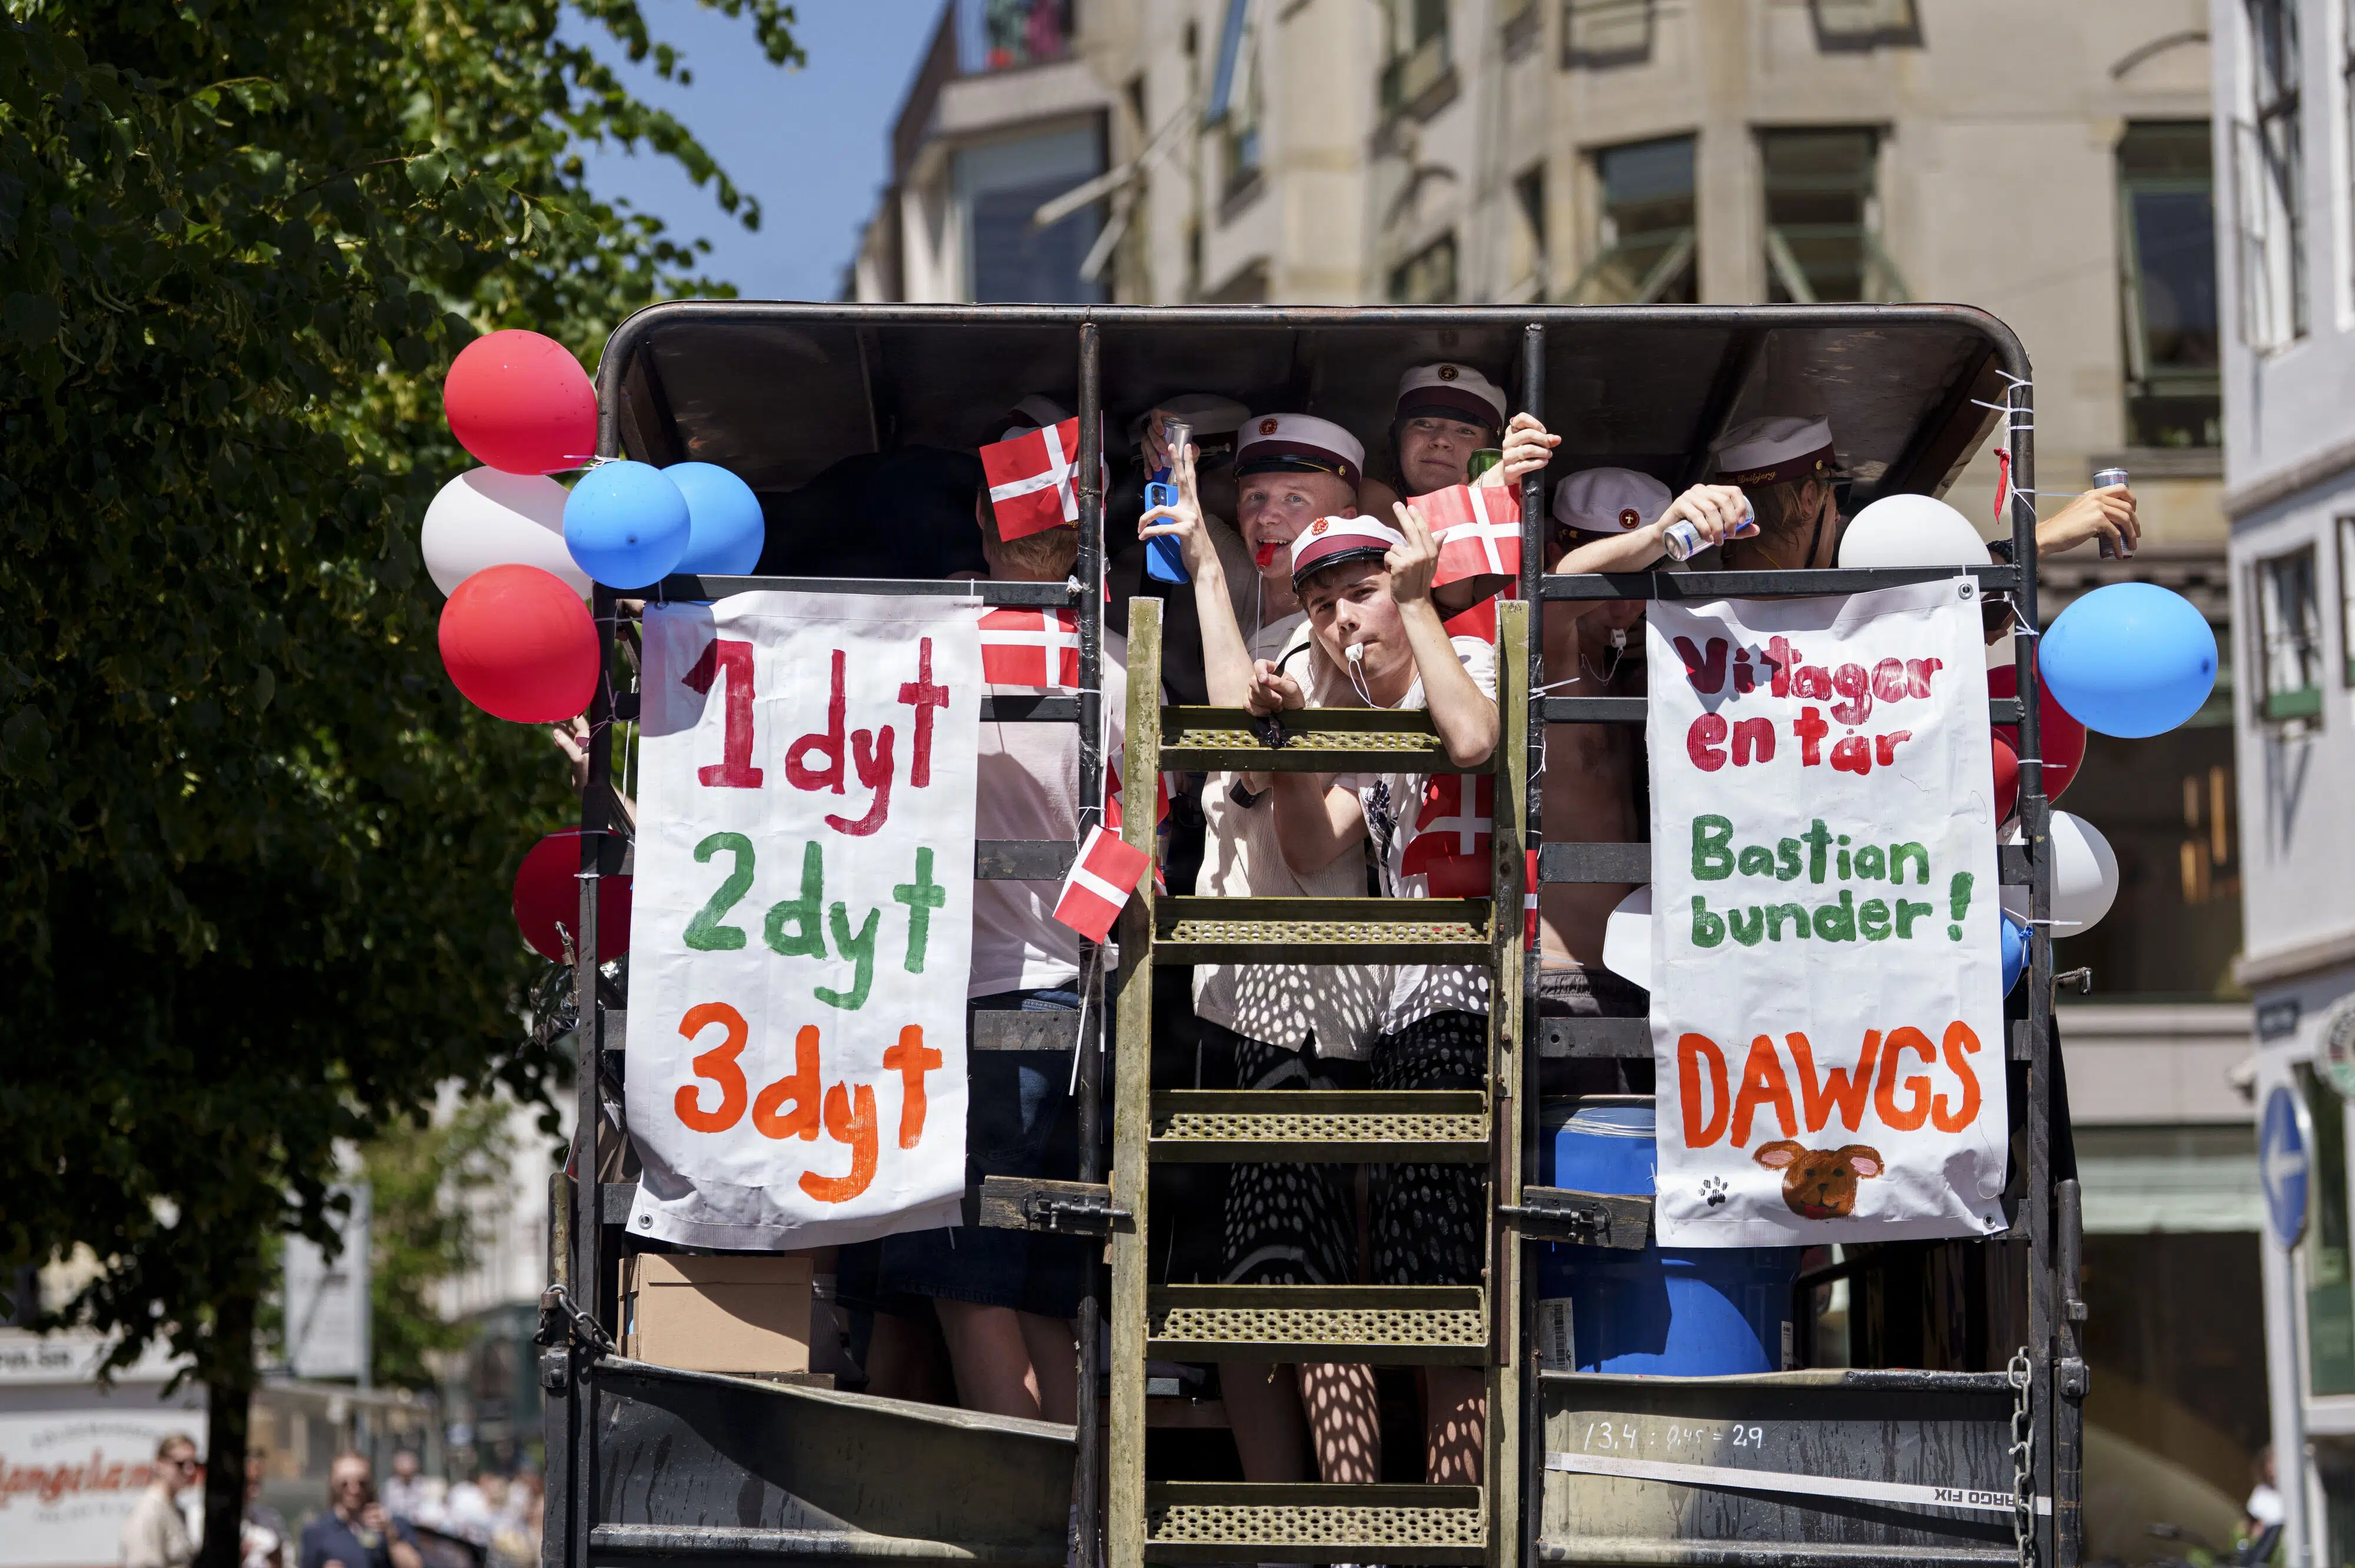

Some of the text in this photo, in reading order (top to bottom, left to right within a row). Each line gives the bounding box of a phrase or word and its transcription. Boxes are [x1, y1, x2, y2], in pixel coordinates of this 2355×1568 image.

[1687, 712, 1776, 772] en
[1691, 814, 1930, 885] Bastian
[1677, 1020, 1982, 1148] DAWGS
[1935, 1489, 2016, 1507] ARGO FIX
